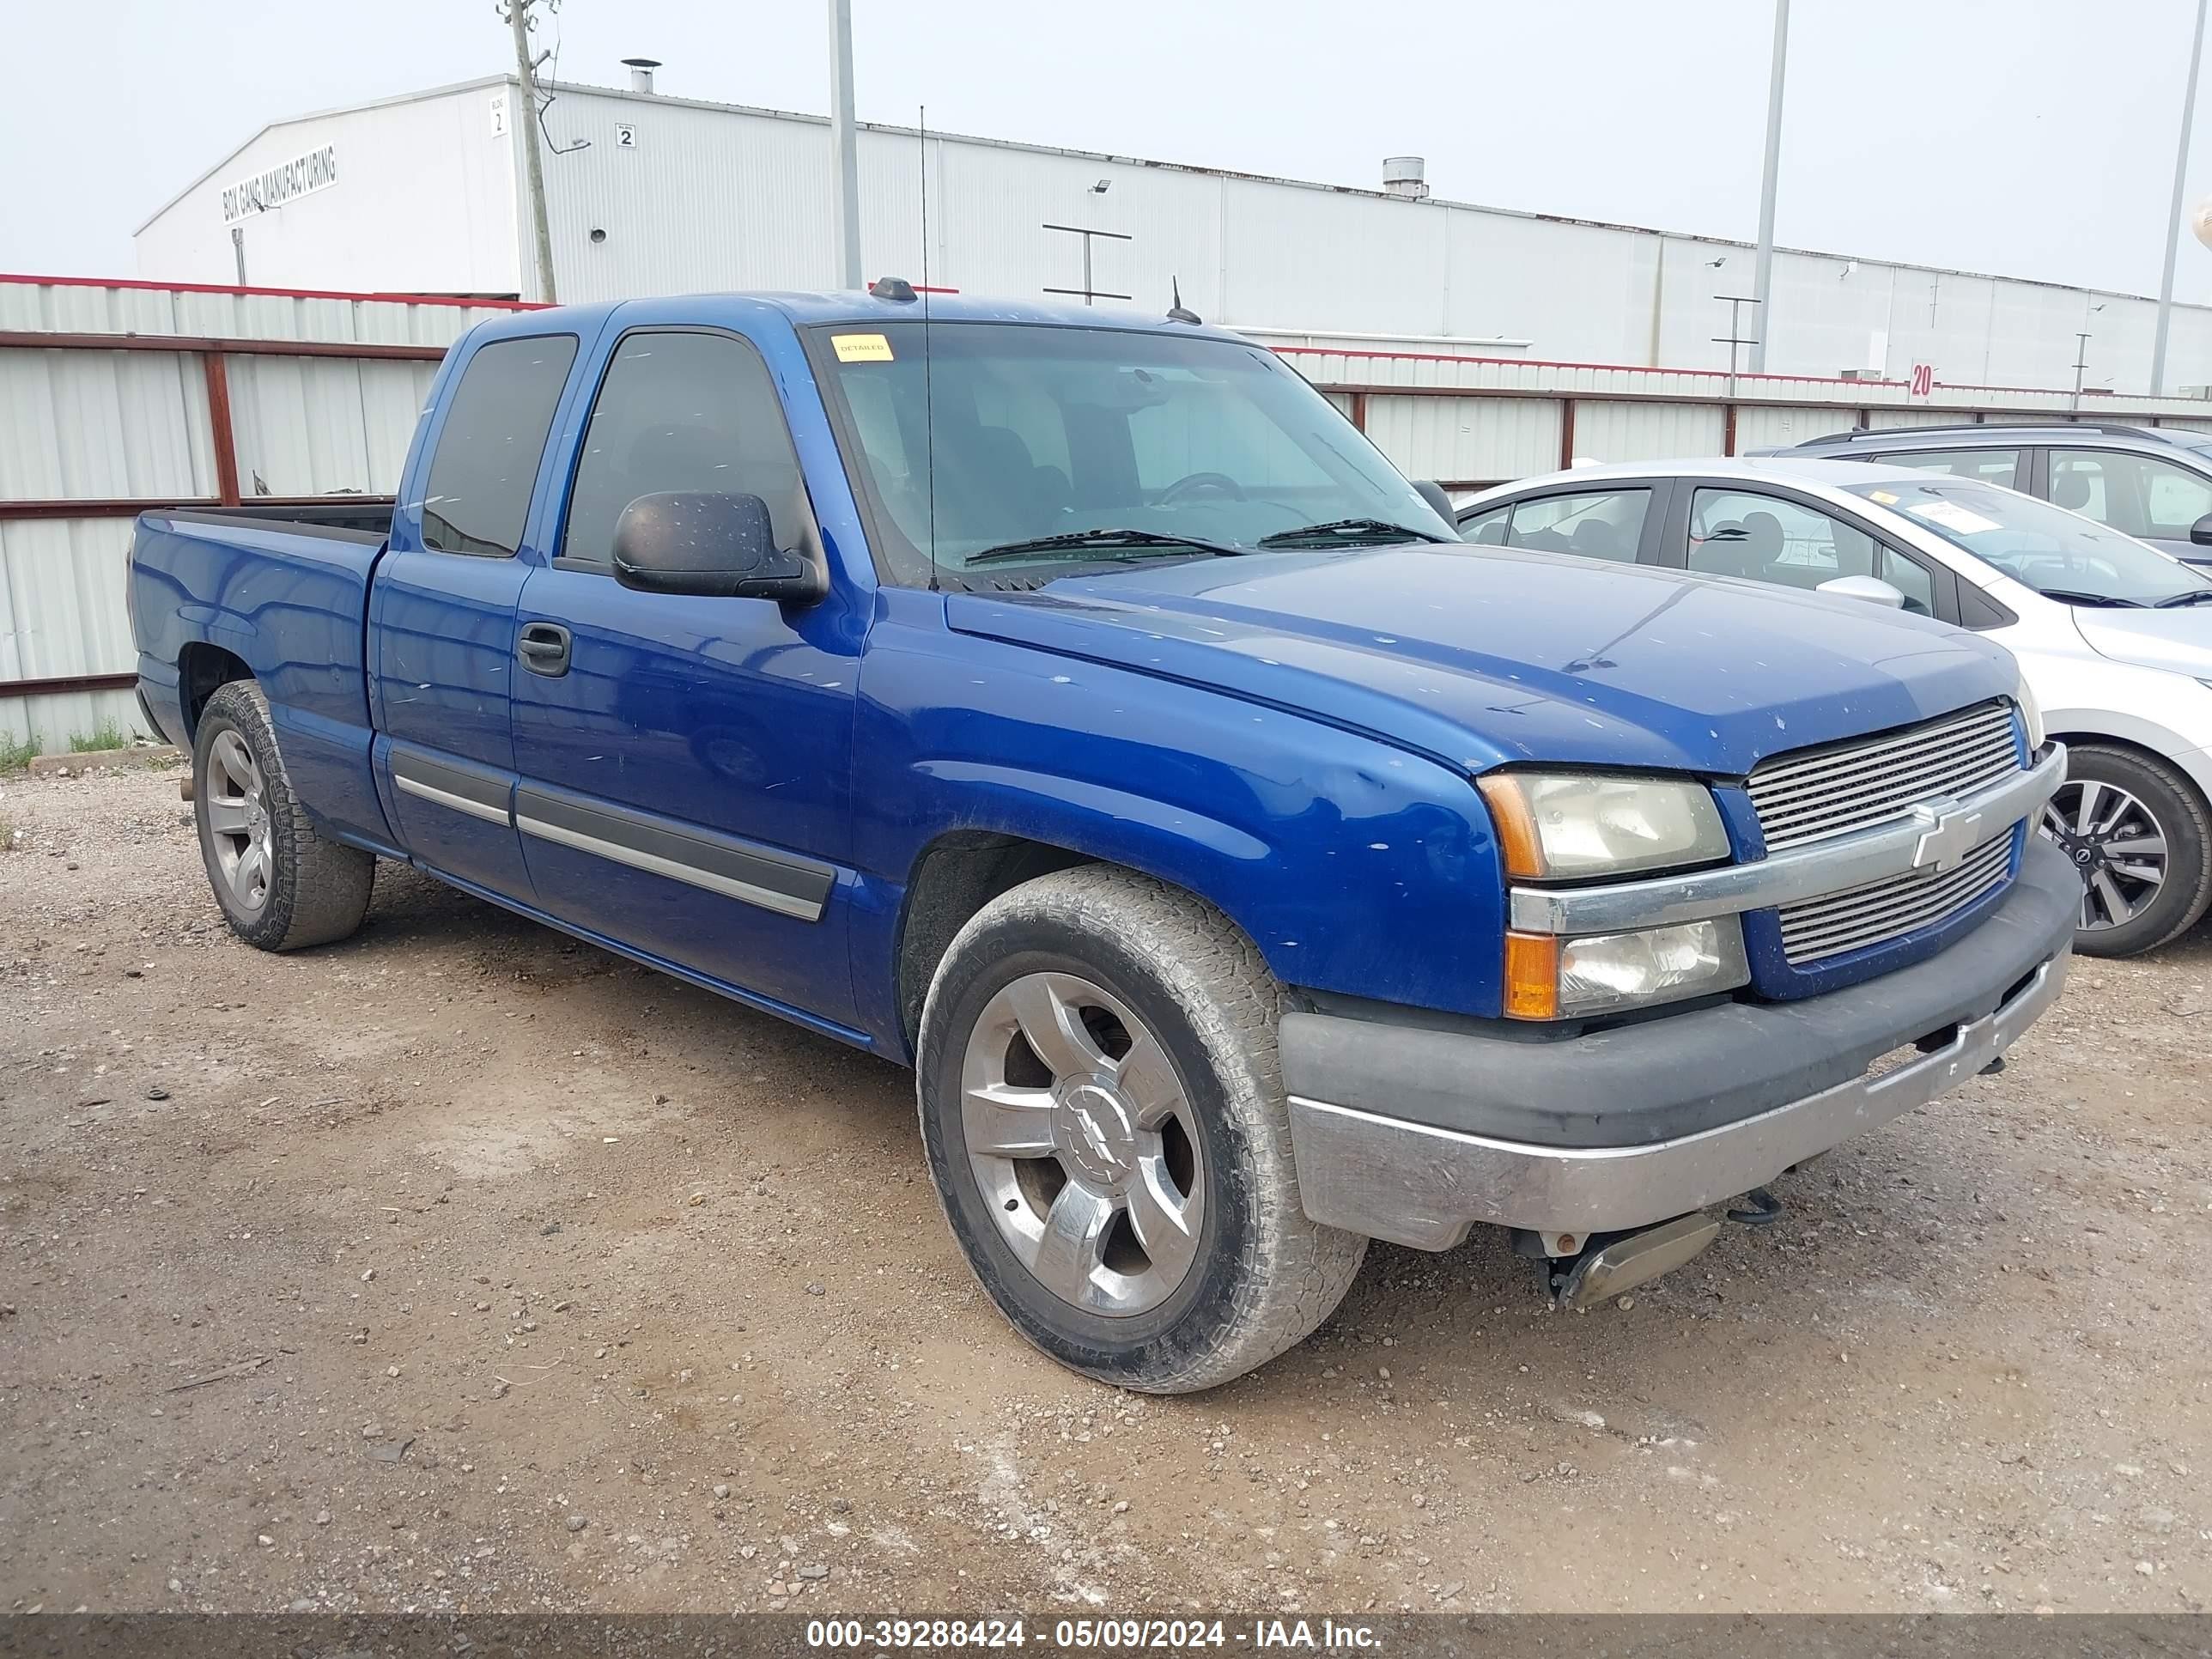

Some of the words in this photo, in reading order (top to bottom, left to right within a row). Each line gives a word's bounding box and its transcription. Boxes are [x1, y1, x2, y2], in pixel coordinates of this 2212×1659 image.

[495, 112, 502, 131] 2
[621, 130, 632, 145] 2
[222, 186, 240, 222] BOX
[262, 145, 336, 207] MANUFACTURING
[1912, 364, 1931, 395] 20
